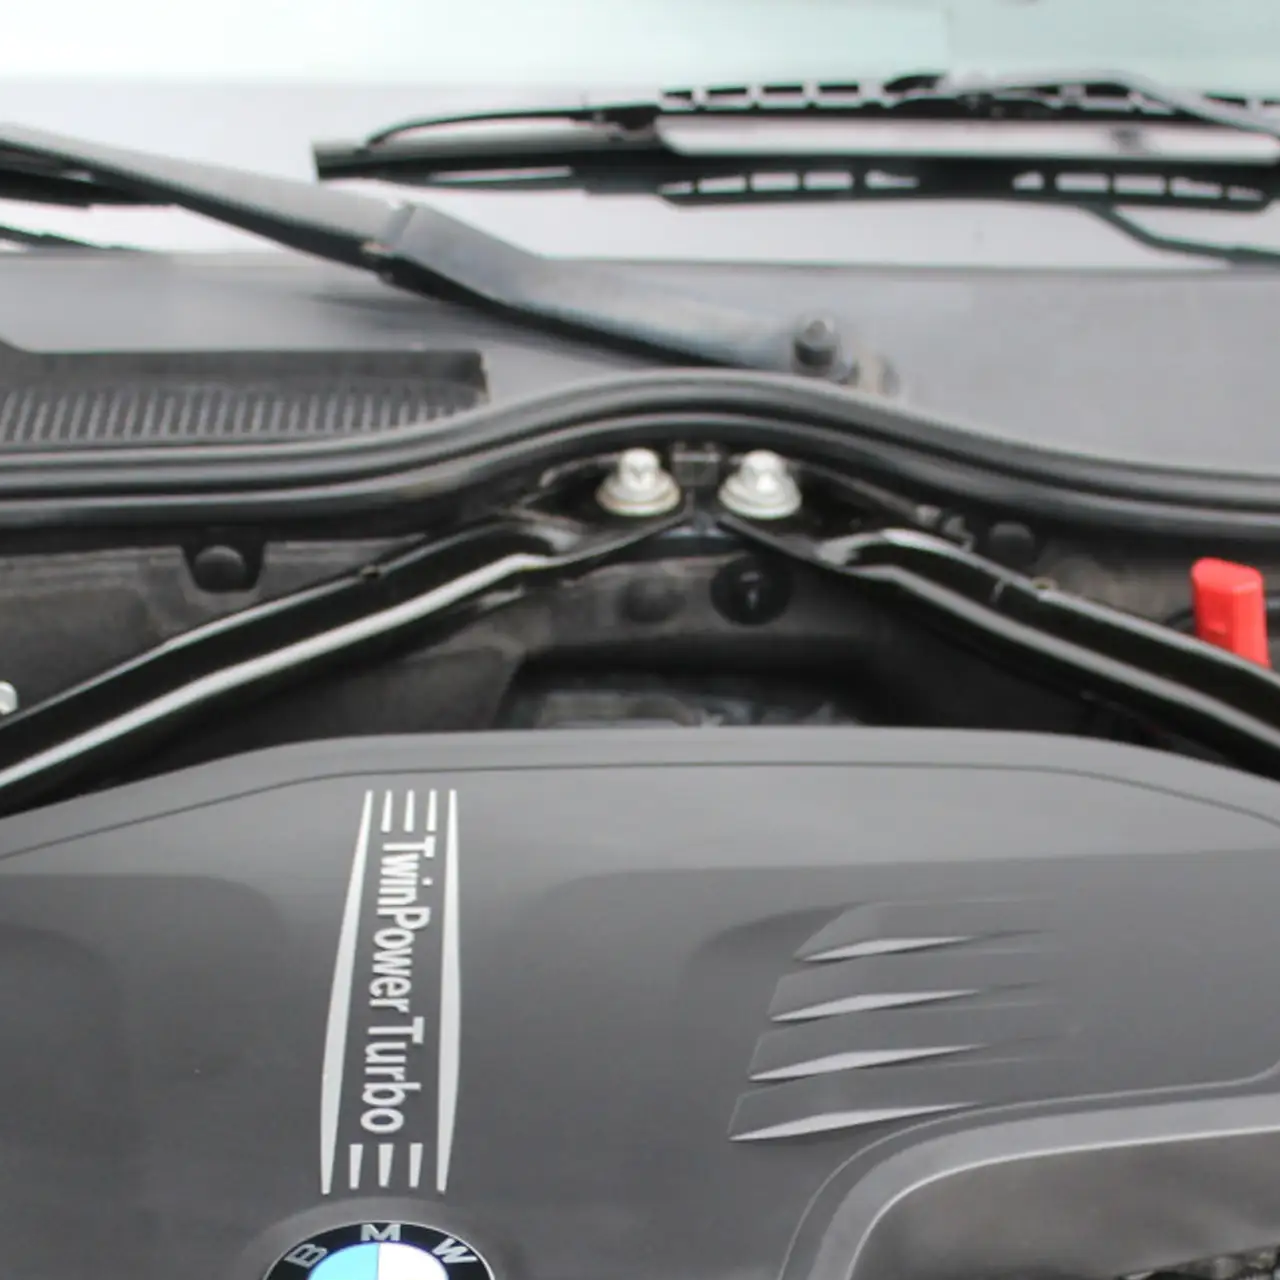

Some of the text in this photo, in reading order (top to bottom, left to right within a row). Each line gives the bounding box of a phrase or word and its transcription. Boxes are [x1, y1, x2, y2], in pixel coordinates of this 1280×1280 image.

[360, 835, 436, 1134] TwinPower Turbo
[284, 1223, 478, 1269] BMW
